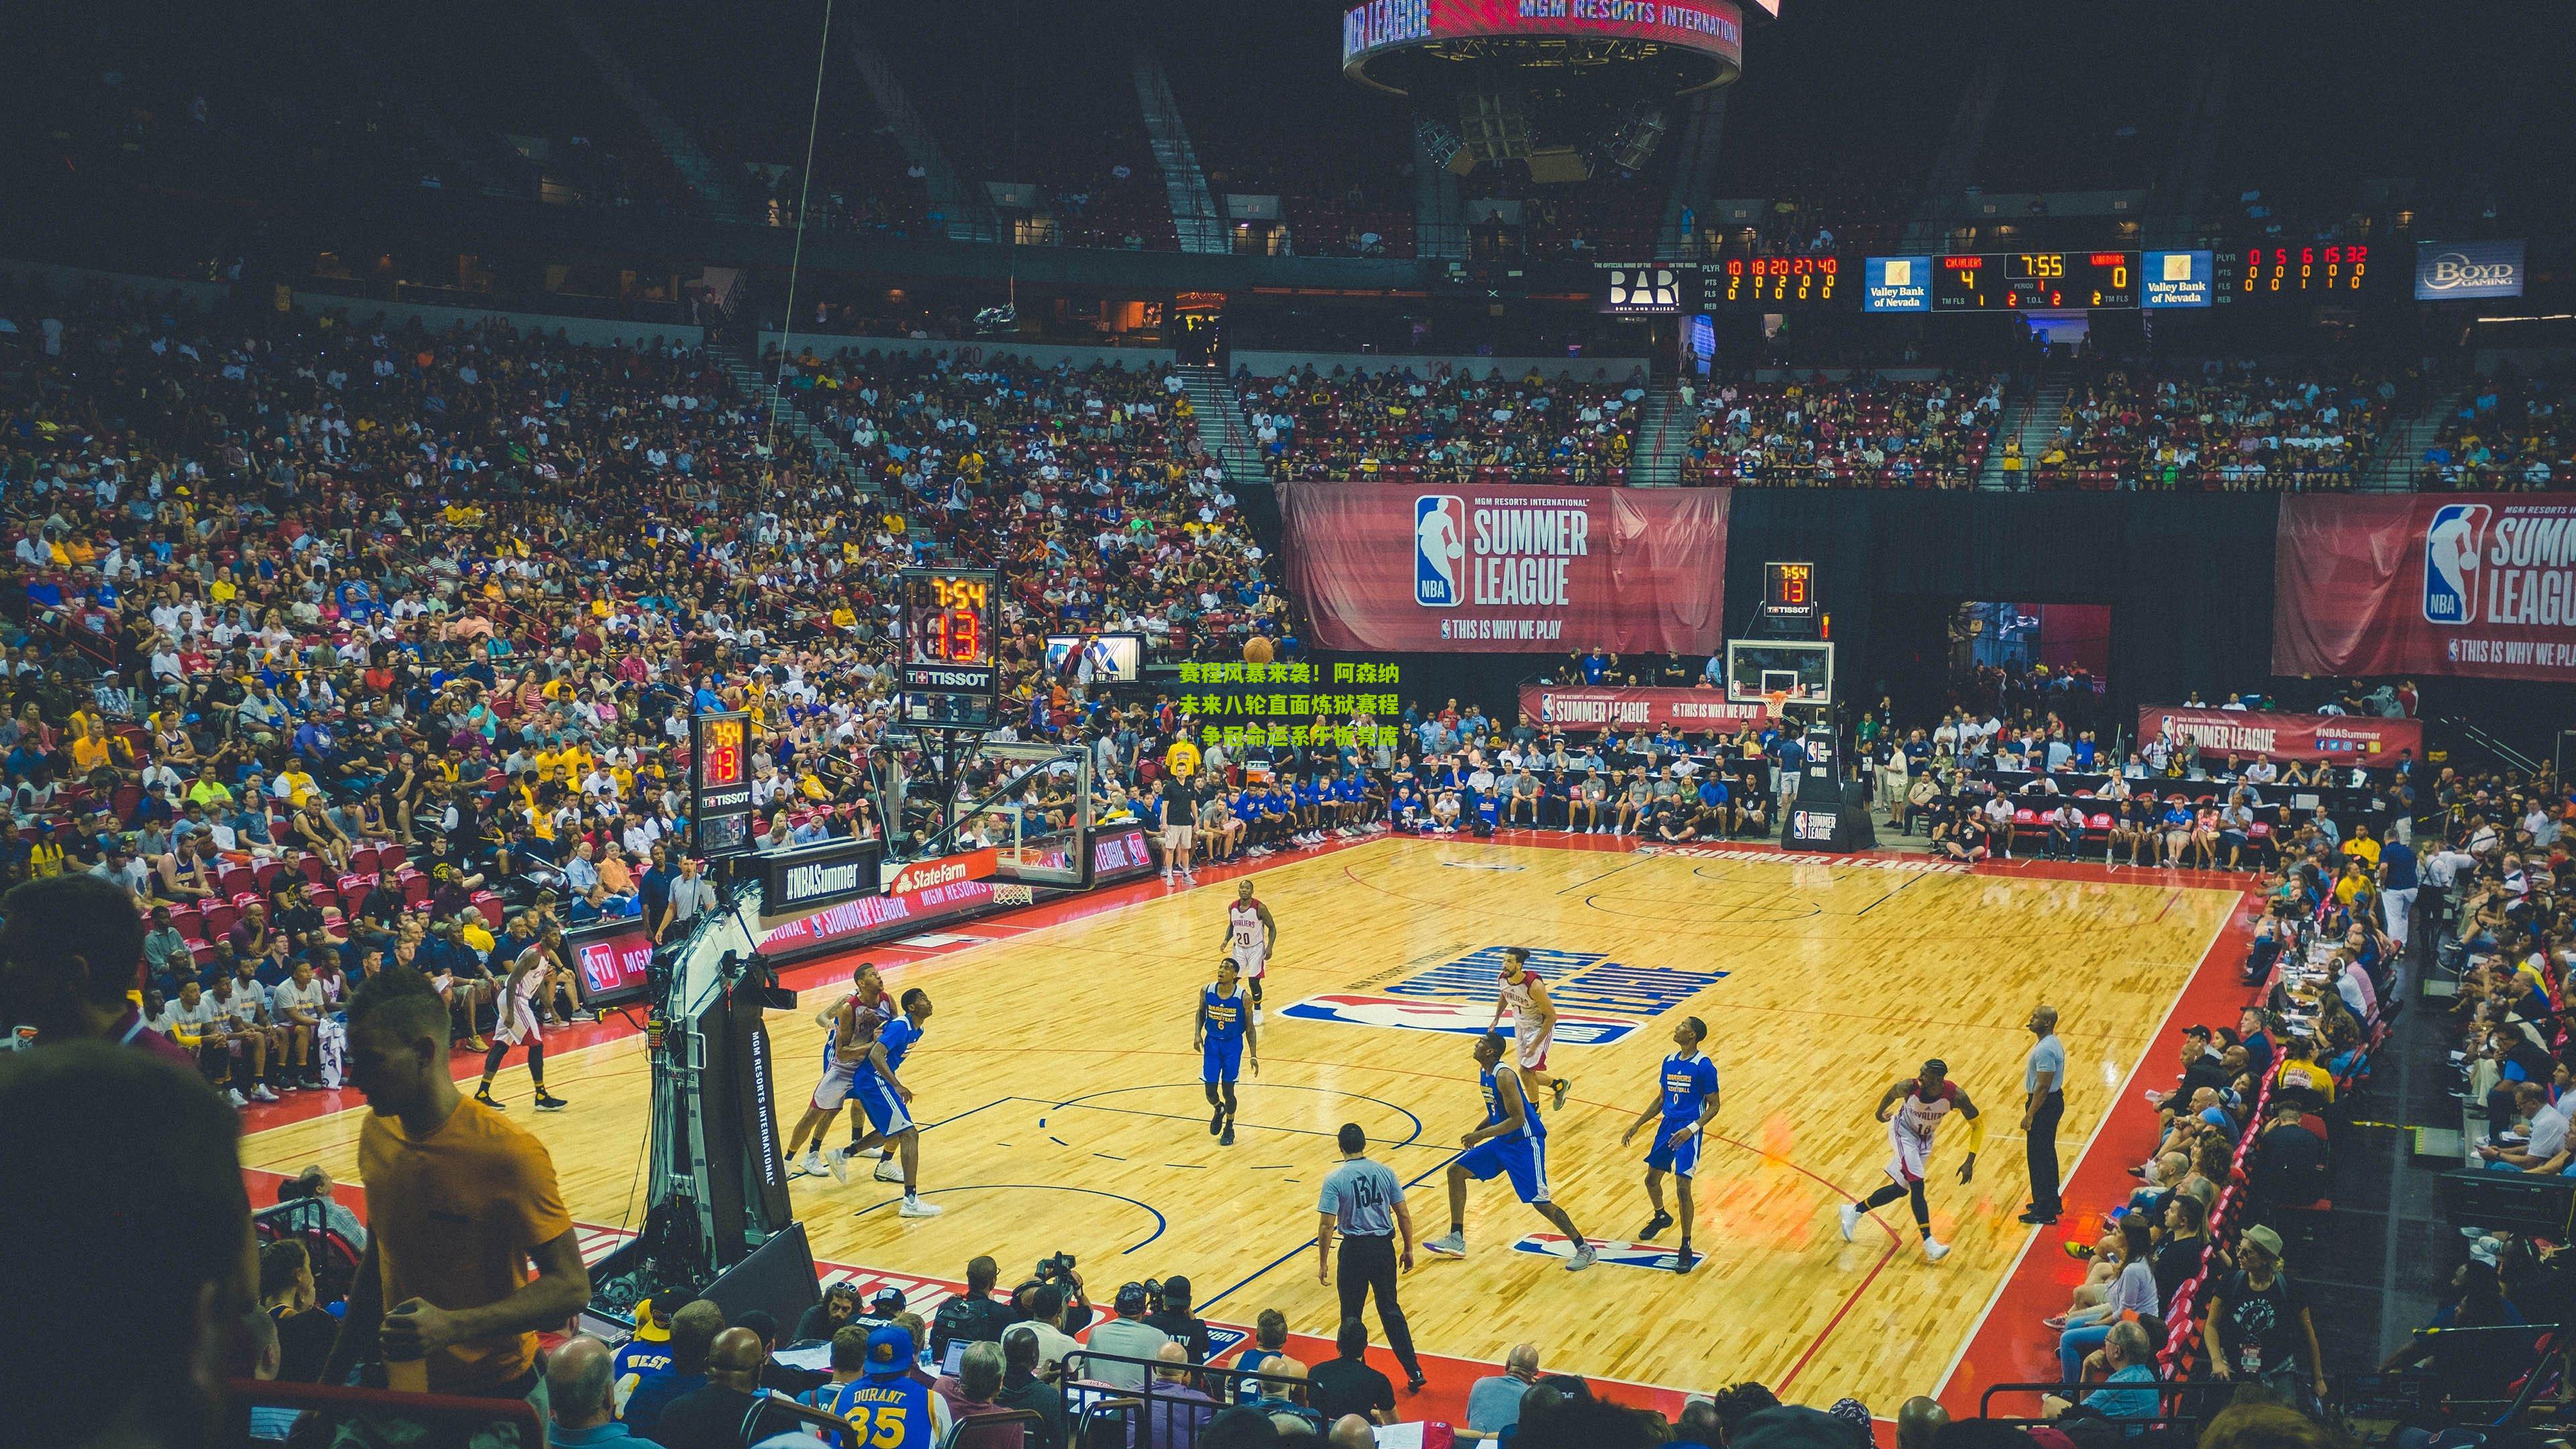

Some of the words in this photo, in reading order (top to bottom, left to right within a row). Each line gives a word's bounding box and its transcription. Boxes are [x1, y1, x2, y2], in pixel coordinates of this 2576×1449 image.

[1368, 0, 1431, 47] LEAGUE
[2021, 256, 2063, 276] 7:55
[2216, 254, 2235, 262] PLYR
[2249, 249, 2260, 266] 0
[2276, 248, 2287, 265] 5
[2302, 248, 2313, 264] 6
[2324, 247, 2340, 263] 15
[2347, 246, 2367, 263] 32
[1703, 265, 1719, 273] PLYR
[1728, 260, 1742, 276] 10
[1752, 260, 1765, 275] 18
[1771, 260, 1788, 274] 20
[1794, 260, 1813, 274] 27
[1818, 259, 1836, 274] 40
[1961, 270, 1974, 289] 4
[2112, 266, 2127, 288] 0
[2218, 269, 2231, 277] PTS
[1870, 286, 1896, 298] Valley
[1899, 285, 1924, 297] Bank
[2148, 282, 2176, 294] Valley
[2179, 280, 2206, 292] Bank
[2461, 278, 2513, 286] GAMING
[1874, 297, 1884, 307] of
[1886, 296, 1920, 307] Nevada
[2116, 294, 2129, 303] FLS
[2151, 293, 2161, 303] of
[2164, 292, 2200, 303] Nevada
[1494, 498, 1527, 506] RESORTS
[1529, 498, 1587, 506] INTERNATIONAL
[2505, 506, 2526, 514] MGM
[2528, 506, 2567, 514] RESORTS
[1474, 509, 1587, 556] SUMMER
[1475, 558, 1569, 605] LEAGUE
[1780, 566, 1808, 580] 7:54
[932, 579, 985, 610] 7:54
[1422, 580, 1444, 598] NBA
[1783, 580, 1805, 603] 13
[2430, 594, 2455, 614] NBA
[939, 612, 979, 661] 13
[1452, 619, 1477, 639] THIS
[1479, 620, 1490, 639] IS
[1492, 620, 1516, 639] WHY
[1518, 620, 1534, 639] WE
[1538, 620, 1562, 639] PLAY
[2461, 639, 2487, 662] THIS
[2491, 641, 2503, 662] IS
[2506, 642, 2534, 665] WHY
[2536, 643, 2554, 665] WE
[928, 672, 989, 687] TISSOT
[1556, 701, 1606, 723] SUMMER
[1680, 703, 1697, 718] THIS
[1699, 704, 1707, 718] IS
[1708, 704, 1727, 718] WHY
[1727, 704, 1739, 718] WE
[1739, 704, 1758, 719] PLAY
[2231, 726, 2276, 752] LEAGUE
[2316, 728, 2381, 740] #NBASummer
[717, 749, 736, 781] 13
[1811, 767, 1827, 777] @NBA
[716, 792, 750, 806] TISSOT
[1809, 815, 1836, 829] SUMMER
[1808, 827, 1831, 841] LEAGUE
[1099, 840, 1128, 871] LEAGUE
[1134, 840, 1146, 858] TV
[1667, 849, 1830, 865] SUMMER
[1835, 857, 1976, 874] LEAGUE
[786, 863, 858, 900] #NBASummer
[822, 898, 872, 934] SUMMER
[867, 896, 910, 924] LEAGUE
[920, 886, 945, 906] MGM
[1236, 932, 1250, 945] 20
[596, 953, 614, 981] TV
[1218, 1021, 1224, 1030] 6
[752, 1031, 761, 1056] MGM
[754, 1059, 765, 1104] RESORTS
[1674, 1093, 1678, 1105] 0
[759, 1105, 773, 1185] INTERNATIONAL
[1351, 1175, 1383, 1209] 134
[627, 1354, 671, 1371] WEST
[853, 1389, 907, 1405] DURANT
[843, 1406, 908, 1449] 35
